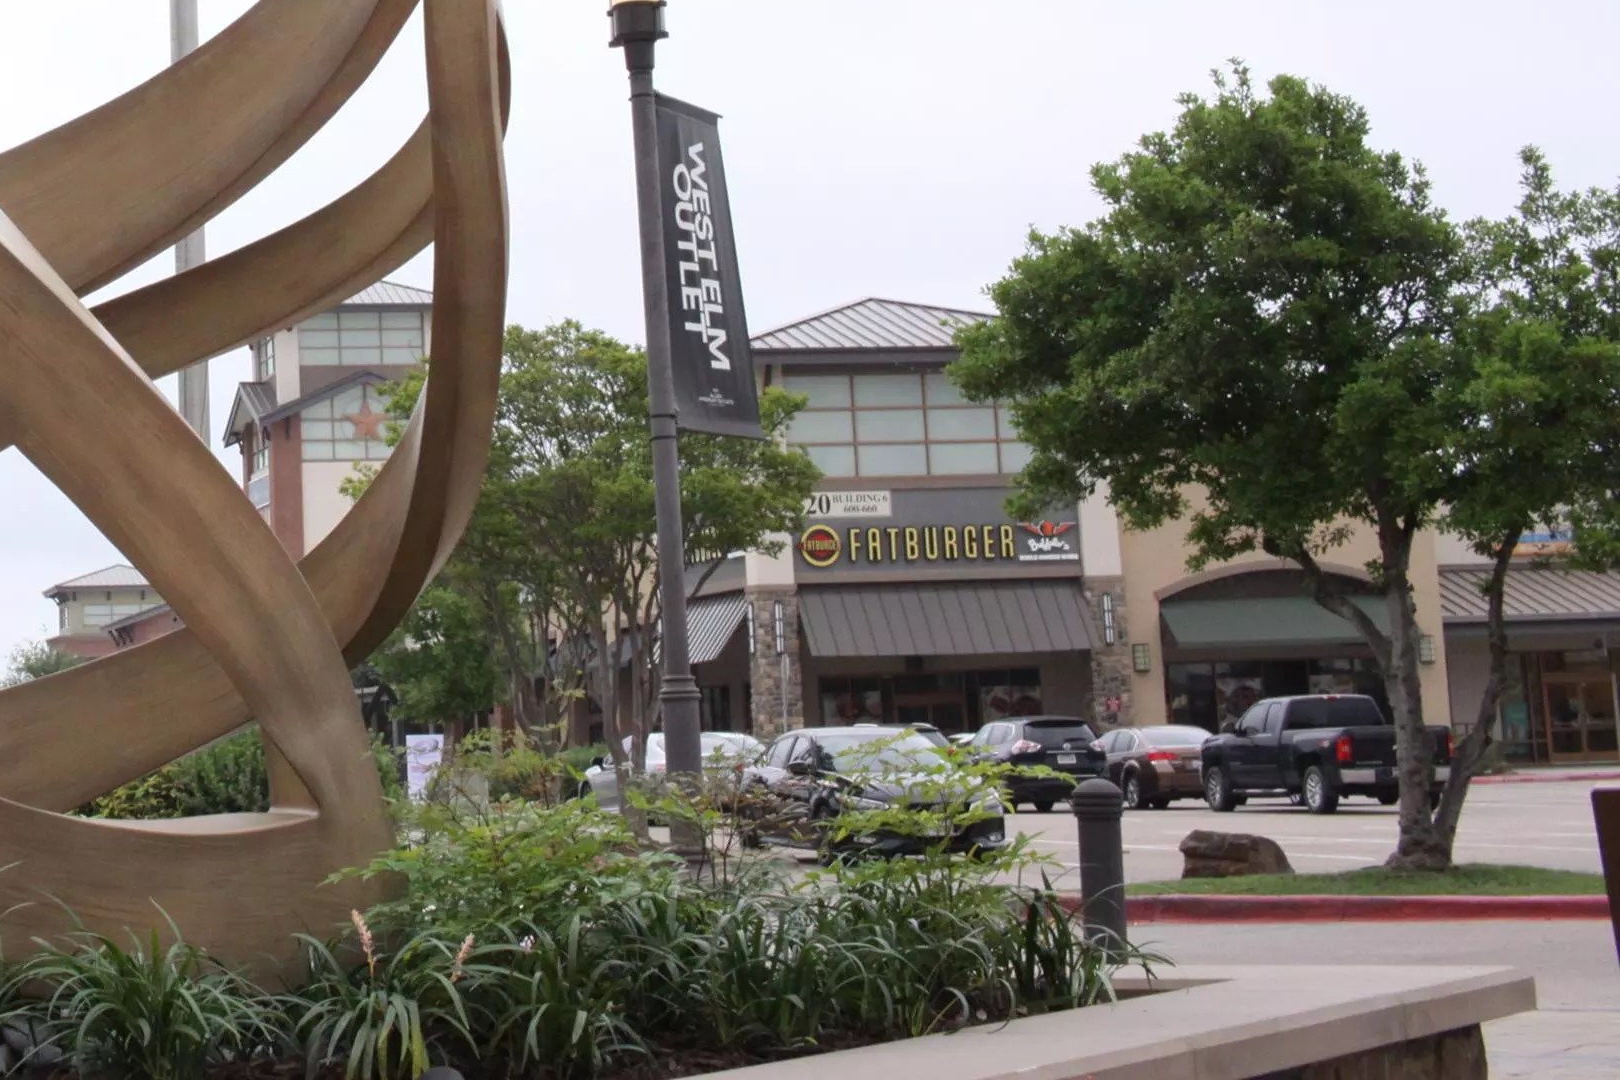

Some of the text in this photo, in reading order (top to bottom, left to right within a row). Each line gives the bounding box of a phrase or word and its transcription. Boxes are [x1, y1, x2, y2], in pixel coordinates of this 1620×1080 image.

[688, 142, 718, 271] WEST
[673, 163, 709, 344] OUTLET
[700, 277, 731, 370] ELM
[832, 493, 882, 504] BUILDING
[848, 524, 1015, 561] FATBURGER
